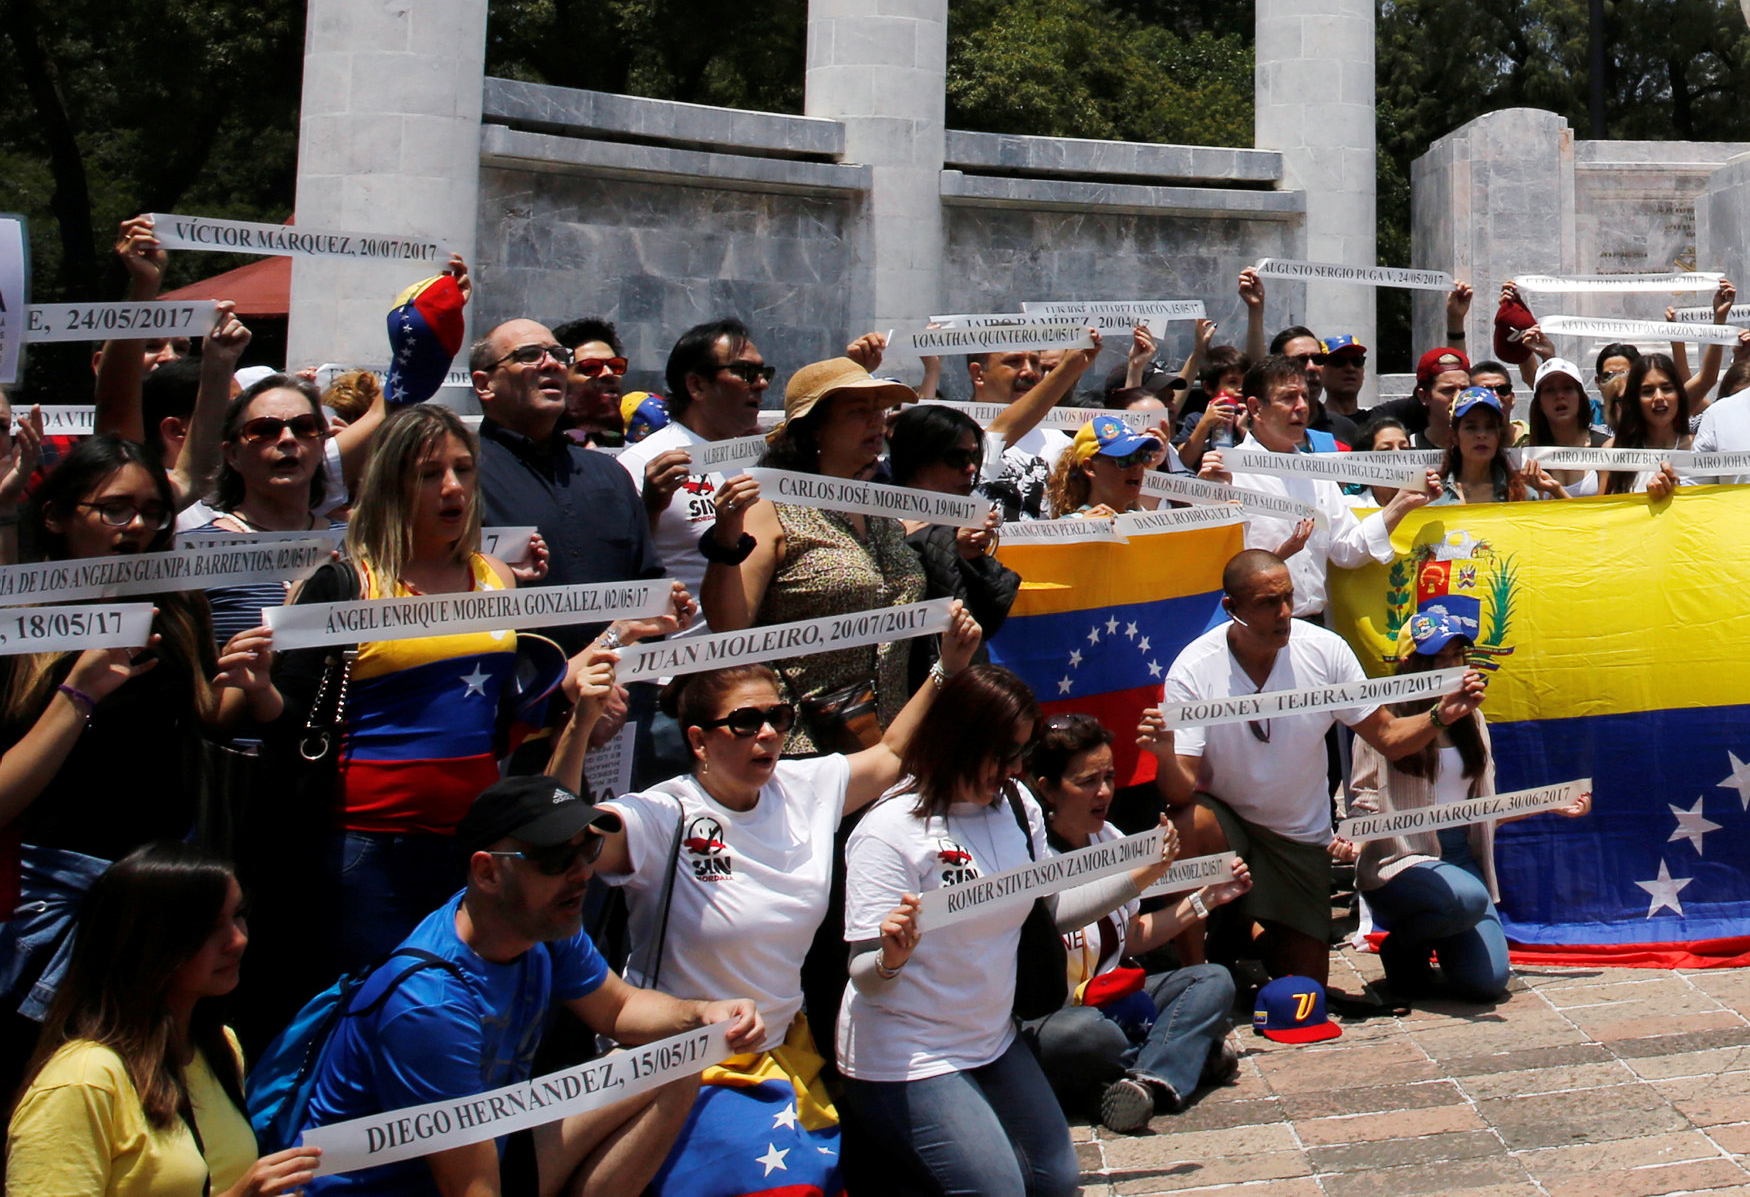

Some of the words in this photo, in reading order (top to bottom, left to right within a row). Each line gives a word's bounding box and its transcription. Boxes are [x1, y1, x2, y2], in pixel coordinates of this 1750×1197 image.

[176, 218, 251, 245] VÍCTOR
[257, 228, 356, 257] MÁRQUEZ,
[360, 239, 437, 261] 20/07/2017
[1262, 261, 1312, 276] AUGUSTO
[1314, 266, 1354, 280] SERGIO
[1355, 268, 1383, 281] PUGA
[1398, 271, 1444, 286] 24/05/2017
[67, 308, 194, 330] 24/05/2017
[978, 328, 1041, 347] QUINTERO,
[1042, 327, 1080, 343] 02/05/17
[703, 446, 731, 465] ALBERT
[1241, 453, 1290, 471] ALMELINA
[1292, 458, 1340, 475] CARRILLO
[1550, 451, 1577, 463] JAIRO
[1579, 451, 1609, 464] JOHAN
[1613, 452, 1640, 464] ORTIZ
[1692, 455, 1720, 469] JAIRO
[779, 477, 834, 502] CARLOS
[837, 481, 870, 505] JOSÉ
[873, 489, 932, 515] MORENO,
[934, 498, 977, 520] 19/04/17
[1173, 480, 1211, 498] EDUARDO
[1133, 511, 1173, 530] DANIEL
[1174, 504, 1234, 526] RODRÍGUEZ,
[1010, 523, 1060, 539] ARANGUREN
[18, 571, 38, 594] DE
[41, 567, 67, 590] LOS
[70, 560, 133, 589] ANGELES
[134, 555, 191, 581] GUANIPA
[194, 550, 274, 576] BARRIENTOS,
[326, 605, 379, 634] ÁNGEL
[383, 599, 449, 629] ENRIQUE
[453, 594, 520, 621] MOREIRA
[525, 586, 601, 616] GONZÁLEZ,
[604, 587, 649, 611] 02/05/17
[17, 612, 122, 639] 18/05/17
[632, 643, 700, 674] JUAN
[704, 625, 825, 662] MOLEIRO,
[830, 607, 927, 641] 20/07/2017
[1179, 697, 1265, 723] RODNEY
[1273, 686, 1355, 711] TEJERA,
[1358, 674, 1444, 700] 20/07/2017
[1351, 812, 1425, 838] EDUARDO
[1428, 798, 1505, 824] MÁRQUEZ,
[1506, 786, 1571, 811] 30/06/2017
[692, 856, 732, 876] SIN
[947, 881, 995, 914] ROMER
[996, 860, 1064, 900] STIVENSON
[1066, 846, 1117, 877] ZAMORA
[1119, 837, 1157, 862] 20/04/17
[366, 1109, 452, 1155] DIEGO
[455, 1076, 626, 1130] HERNÁNDEZ,
[630, 1035, 710, 1081] 15/05/17
